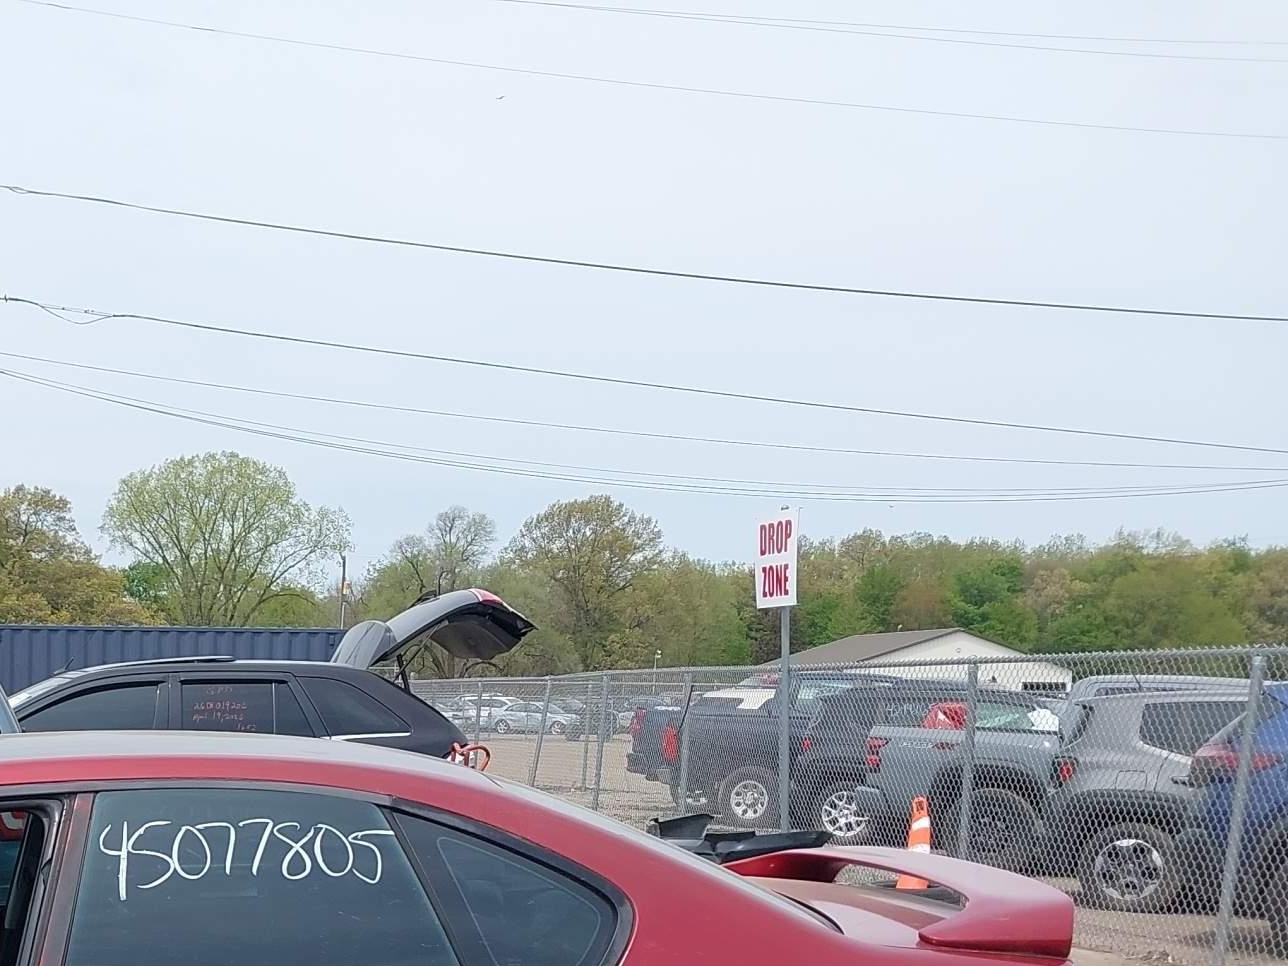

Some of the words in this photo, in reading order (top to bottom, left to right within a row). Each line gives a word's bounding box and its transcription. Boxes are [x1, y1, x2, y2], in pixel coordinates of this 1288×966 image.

[759, 519, 793, 556] DROP
[761, 563, 790, 598] ZONE
[99, 818, 396, 901] 45077805
